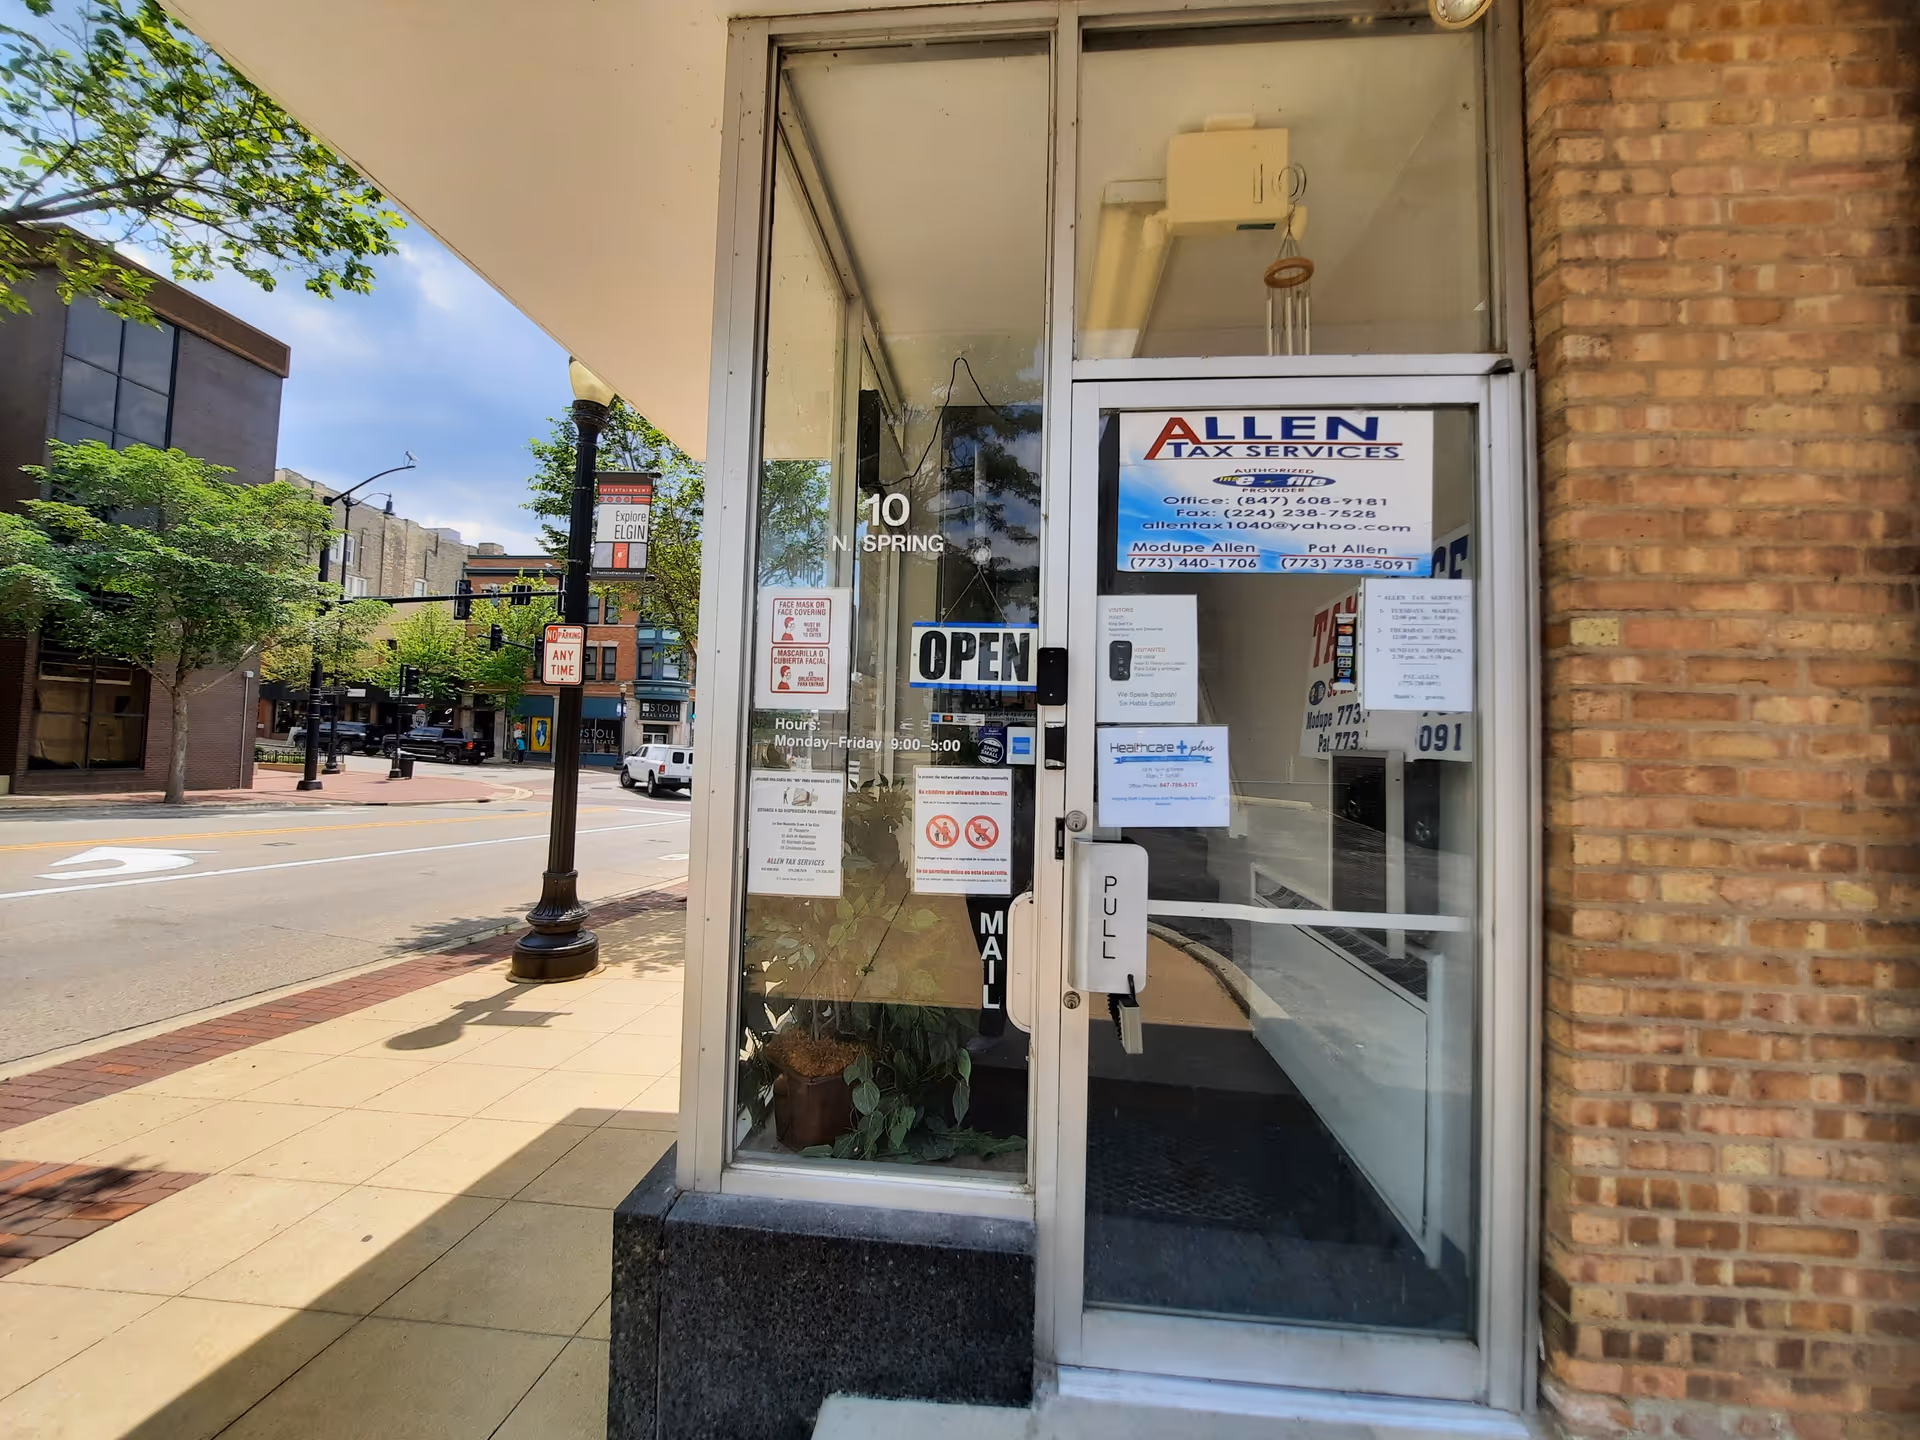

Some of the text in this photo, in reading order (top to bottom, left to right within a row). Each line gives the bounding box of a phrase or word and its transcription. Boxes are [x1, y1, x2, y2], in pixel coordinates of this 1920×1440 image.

[1144, 416, 1378, 460] ALLEN
[1166, 442, 1399, 458] TAX SERVICES
[1287, 476, 1326, 486] file
[1163, 496, 1387, 506] Office: (847) 608-9181
[864, 492, 910, 527] 10
[1224, 509, 1275, 518] (224)
[1283, 509, 1376, 518] 238-7528
[616, 510, 646, 523] Explore
[614, 524, 645, 540] ELGIN
[1142, 521, 1411, 532] allentax1040@yahoo.com
[832, 535, 944, 552] N. SPRING
[1132, 543, 1255, 554] Modupe Allen
[1308, 544, 1388, 554] Pat Allen
[1130, 558, 1257, 570] (773) 440-1706
[1281, 558, 1412, 571] (773) 738-5091
[546, 630, 581, 642] NO PARKING
[552, 650, 574, 661] ANY
[919, 630, 1030, 682] OPEN
[551, 664, 575, 676] TIME
[651, 703, 679, 713] STOLL
[775, 718, 820, 731] Hours:
[1306, 711, 1332, 730] Modupe
[584, 729, 615, 738] STOLL
[984, 744, 999, 753] SHOP
[1110, 740, 1216, 756] Healthcare plus
[1318, 733, 1330, 752] Pat
[981, 749, 999, 758] SMALL
[1103, 876, 1117, 959] PULL
[980, 911, 1003, 1010] MAIL
